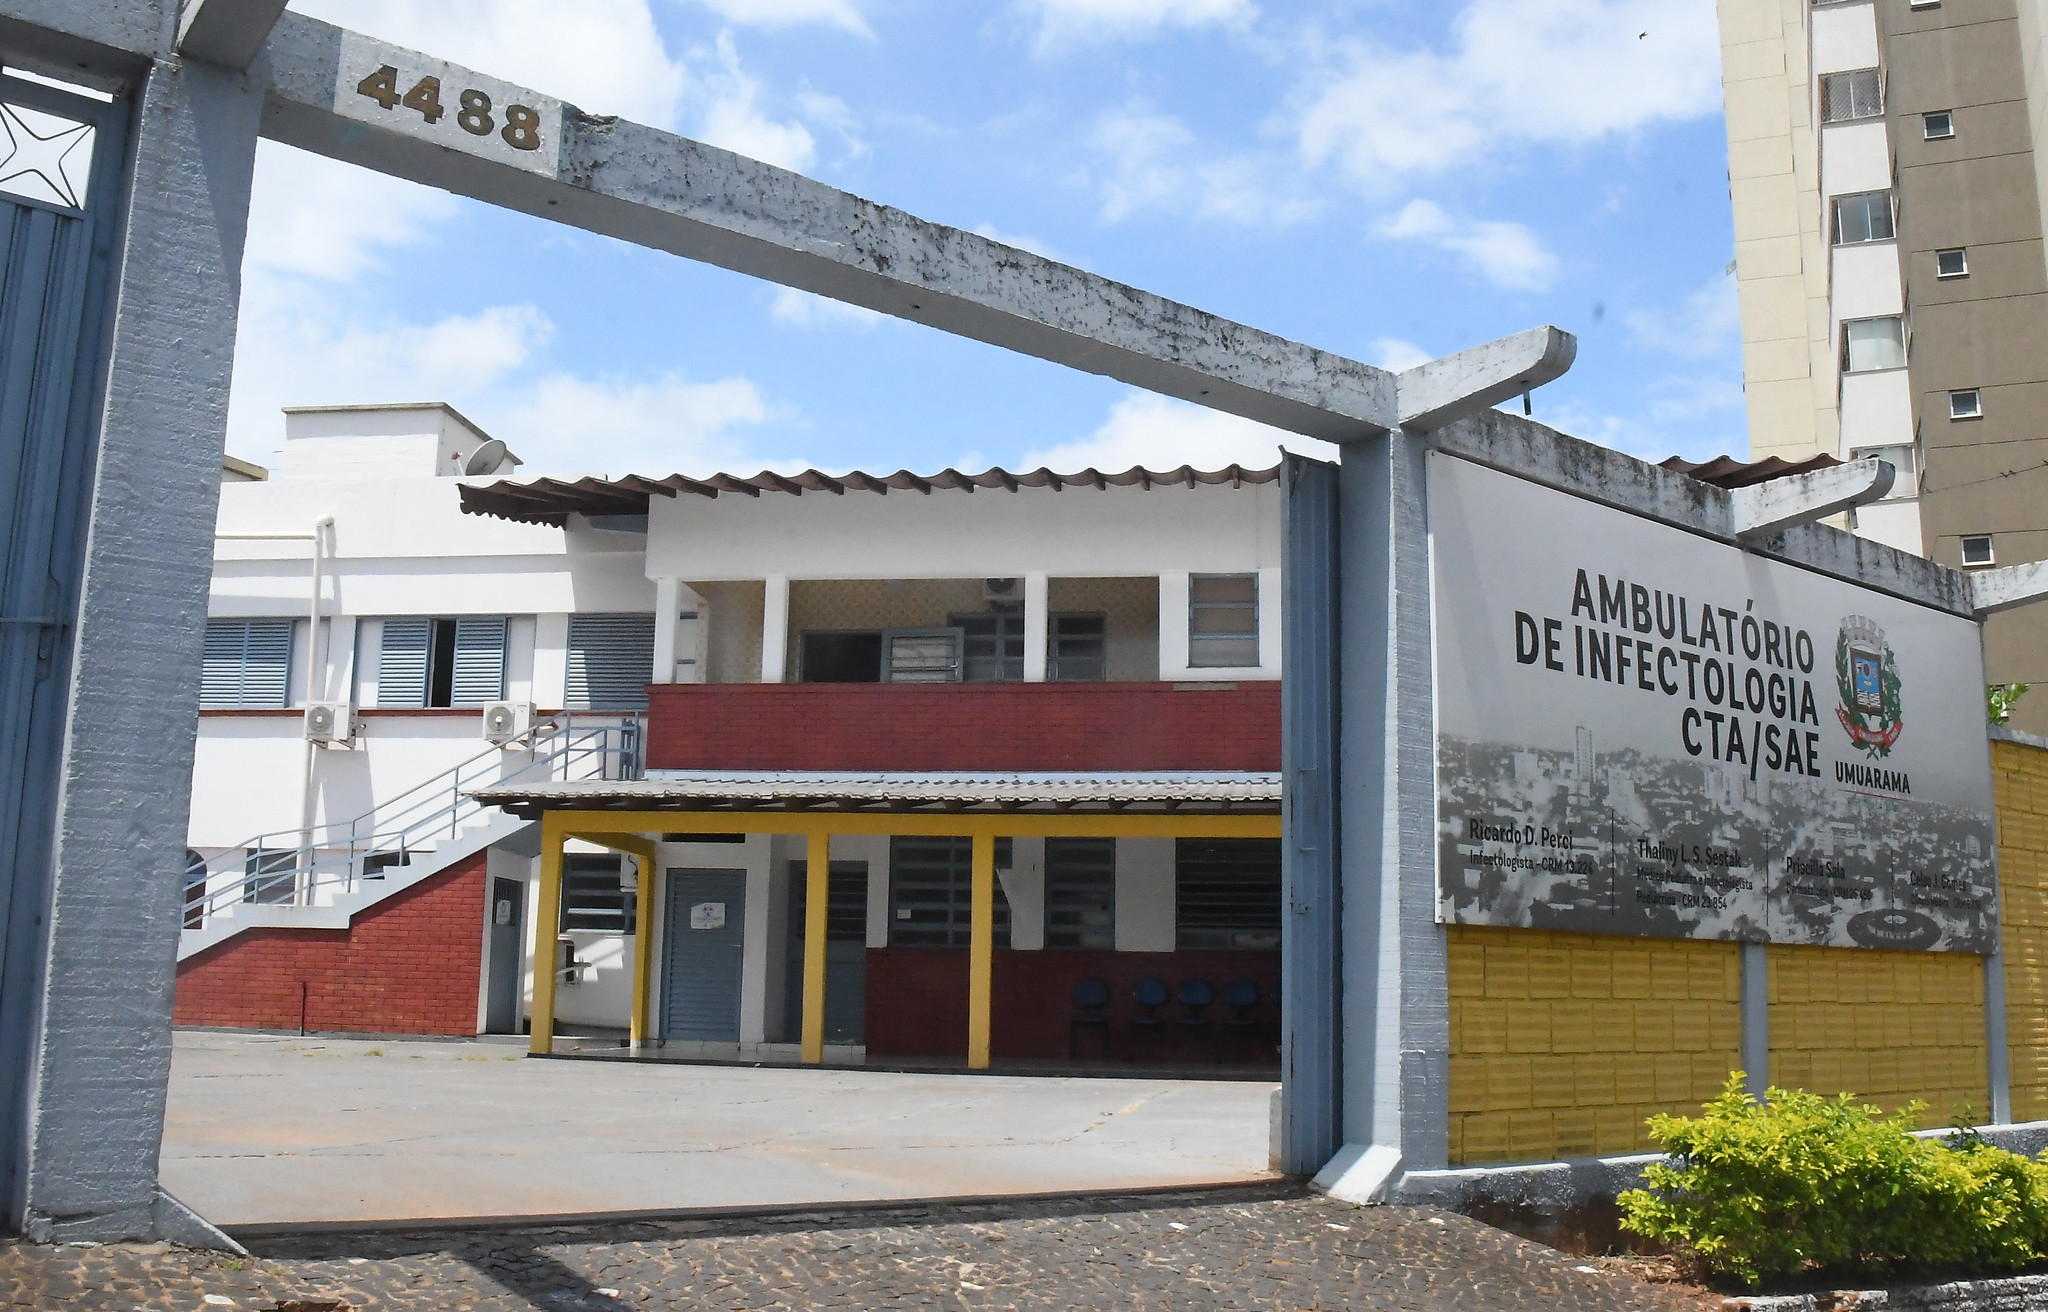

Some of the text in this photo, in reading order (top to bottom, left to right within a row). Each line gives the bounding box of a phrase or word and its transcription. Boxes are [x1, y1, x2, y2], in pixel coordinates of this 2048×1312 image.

[357, 64, 541, 150] 4488
[1571, 568, 1815, 675] AMBULATÓRIO
[1514, 611, 1819, 727] DE INFECTOLOGIA
[1681, 708, 1822, 781] CTA/SAE
[1835, 760, 1911, 794] UMUARAMA
[1469, 818, 1573, 850] Ricardo D. Perci
[1470, 849, 1534, 873] Infectologista
[1541, 857, 1563, 872] CRM
[1637, 838, 1678, 867] Thaliny
[1692, 845, 1703, 864] S.
[1705, 846, 1742, 867] Sestak
[1786, 856, 1846, 878] Priscilla Sala
[1682, 893, 1700, 908] CRM
